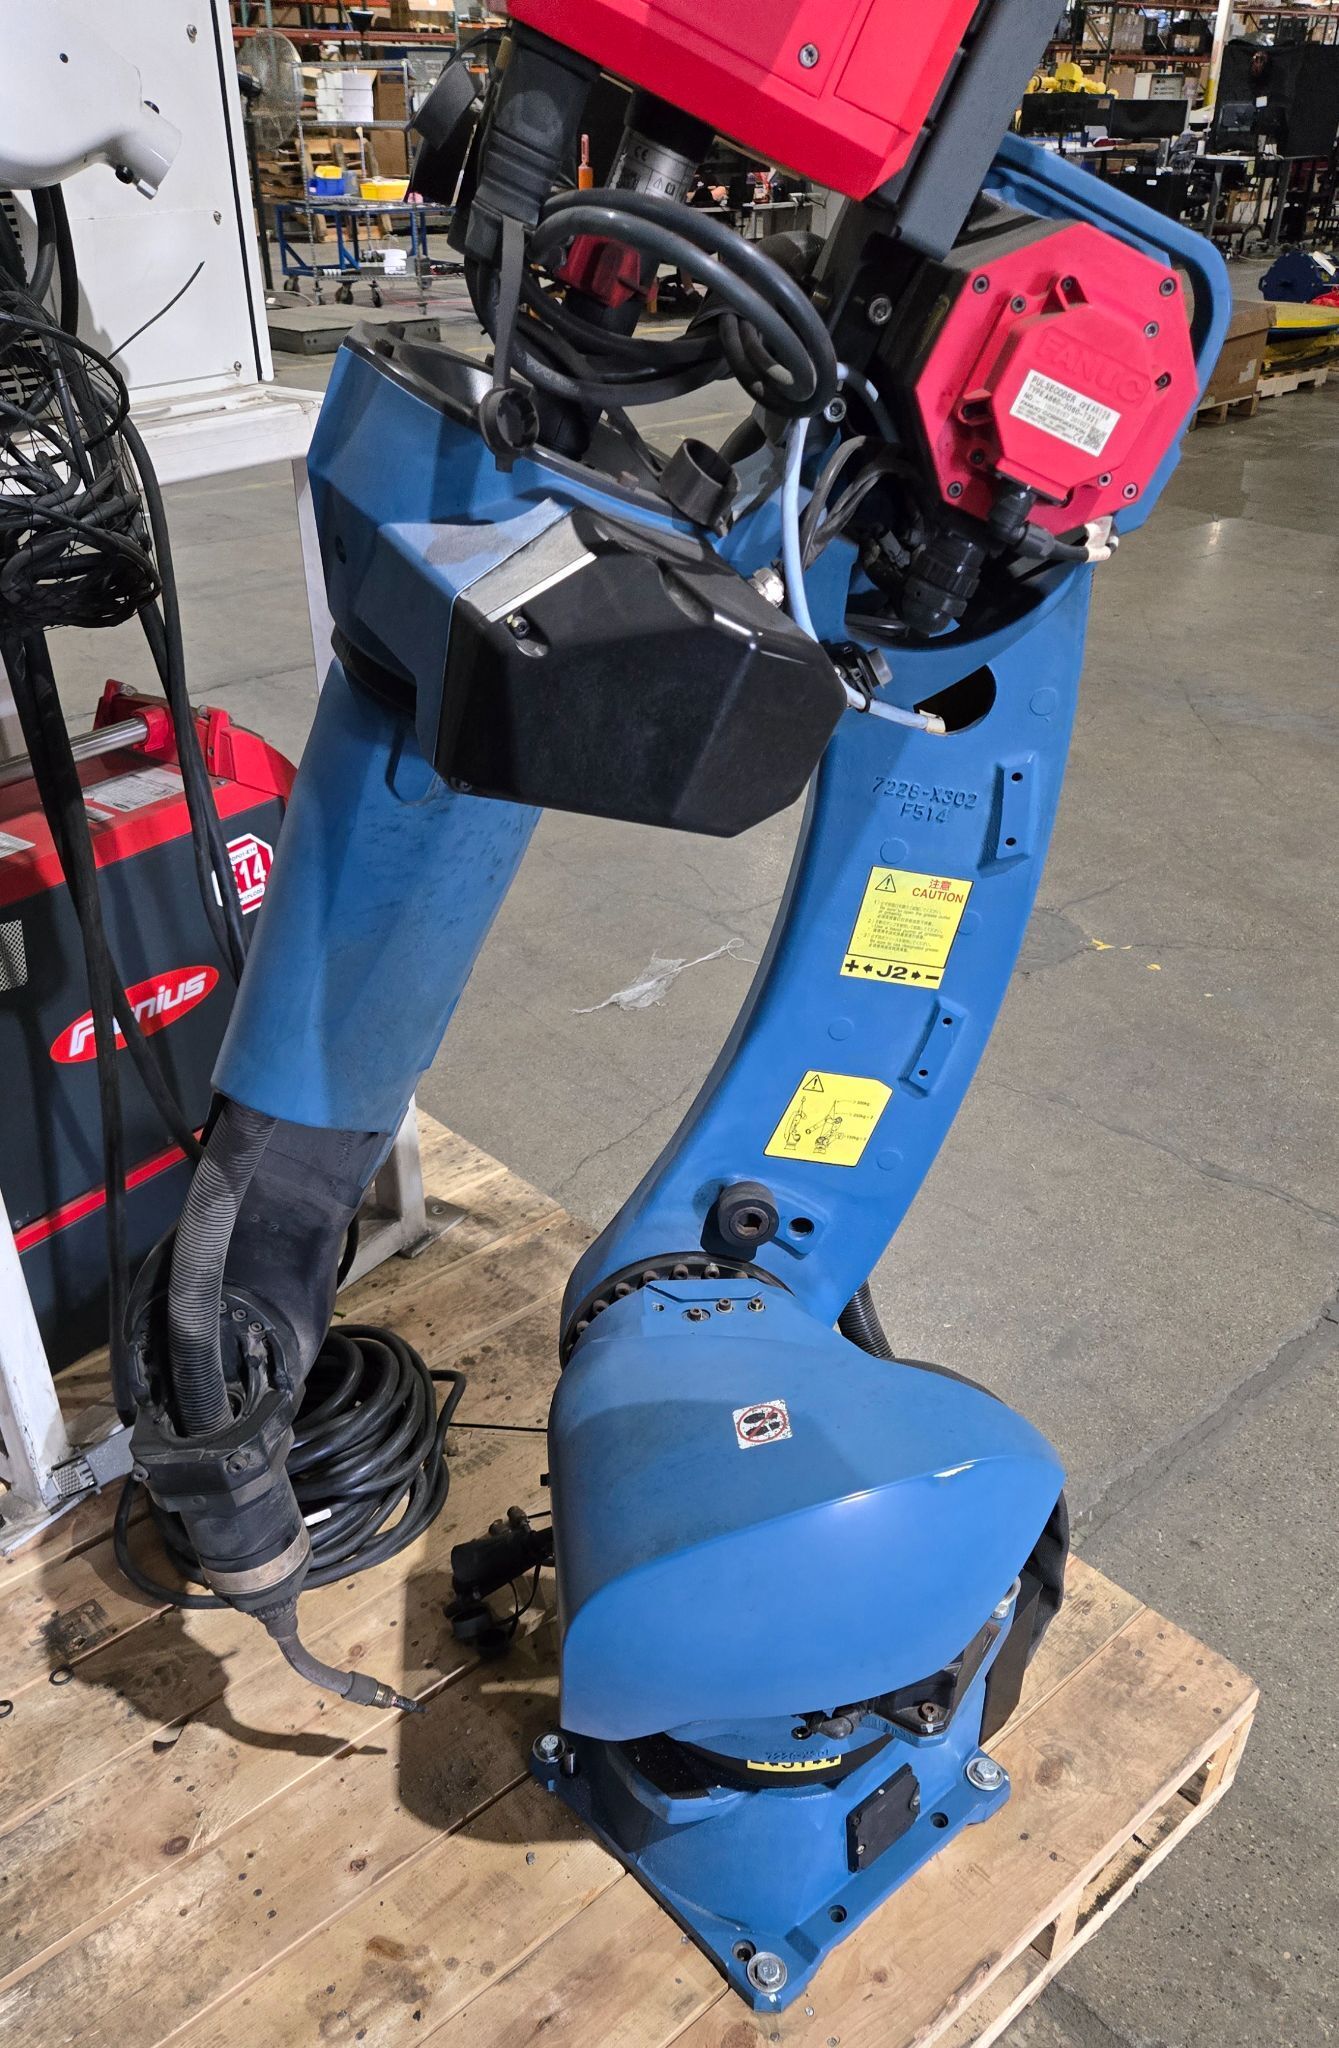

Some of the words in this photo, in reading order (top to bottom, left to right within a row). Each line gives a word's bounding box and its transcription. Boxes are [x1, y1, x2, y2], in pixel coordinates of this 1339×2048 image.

[1035, 332, 1145, 404] FANUC
[1030, 374, 1077, 404] PULSECODER
[900, 801, 949, 823] F514
[230, 853, 266, 893] 14
[912, 887, 964, 903] CAUTION
[876, 965, 908, 980] J2
[68, 971, 207, 1058] Fnius
